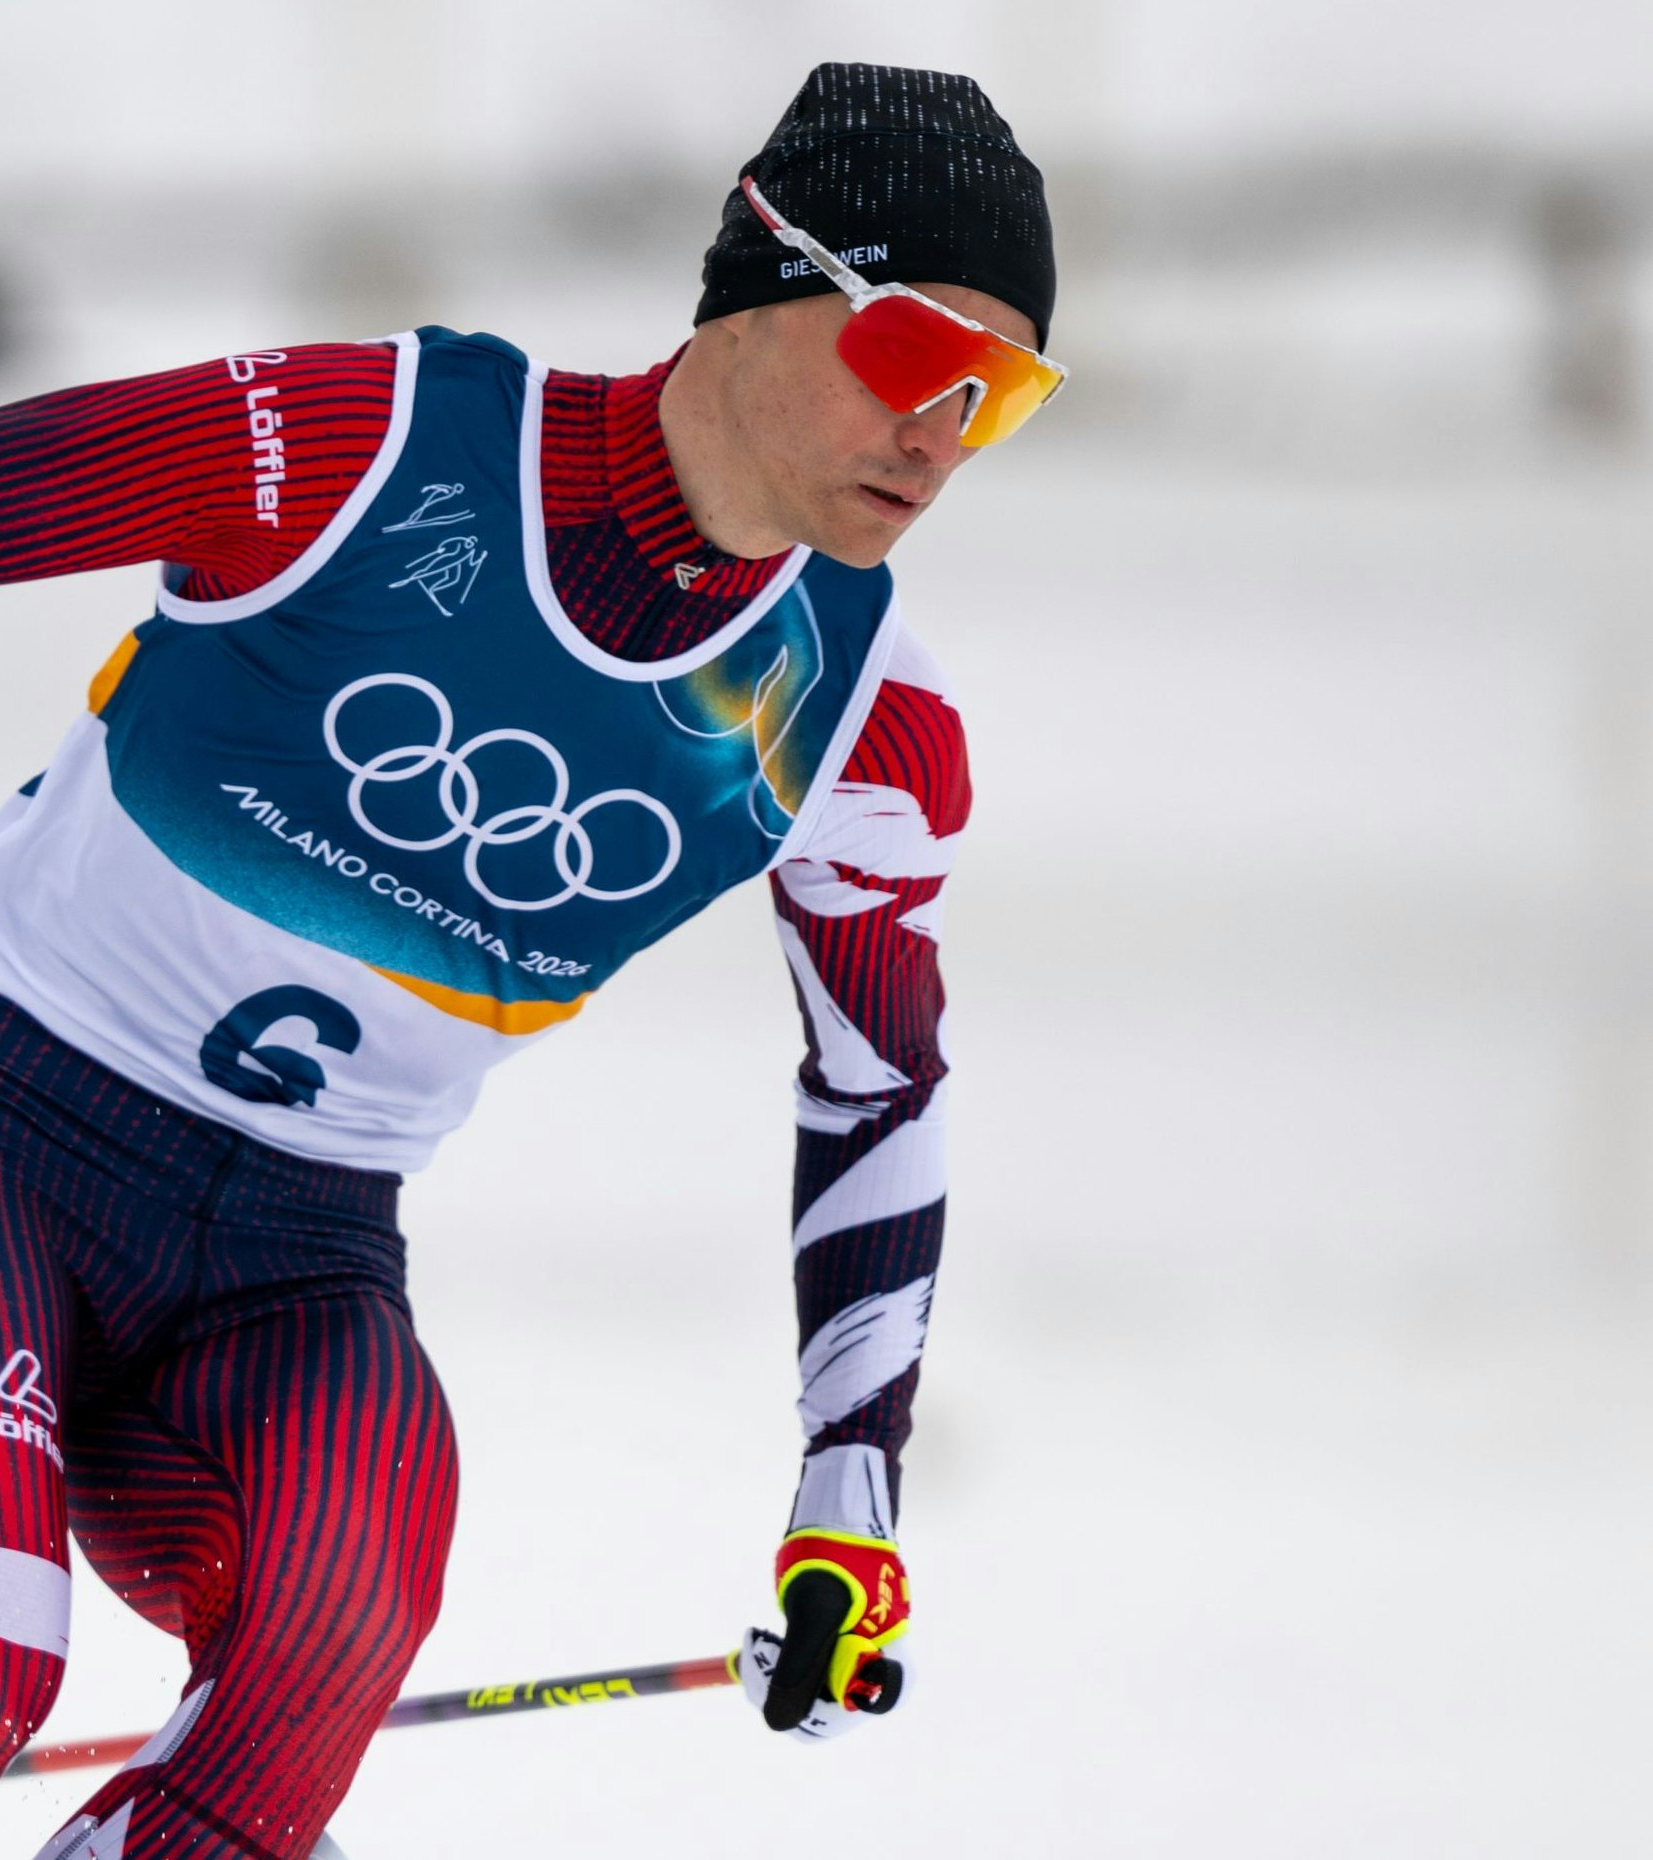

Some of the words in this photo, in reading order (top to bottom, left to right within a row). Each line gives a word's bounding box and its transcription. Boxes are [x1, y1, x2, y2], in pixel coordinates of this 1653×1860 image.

[780, 244, 888, 279] GIESWEIN
[219, 783, 368, 877] MILANO
[369, 872, 510, 963] CORTINA
[516, 950, 593, 977] 2026
[862, 1562, 895, 1633] LEKI
